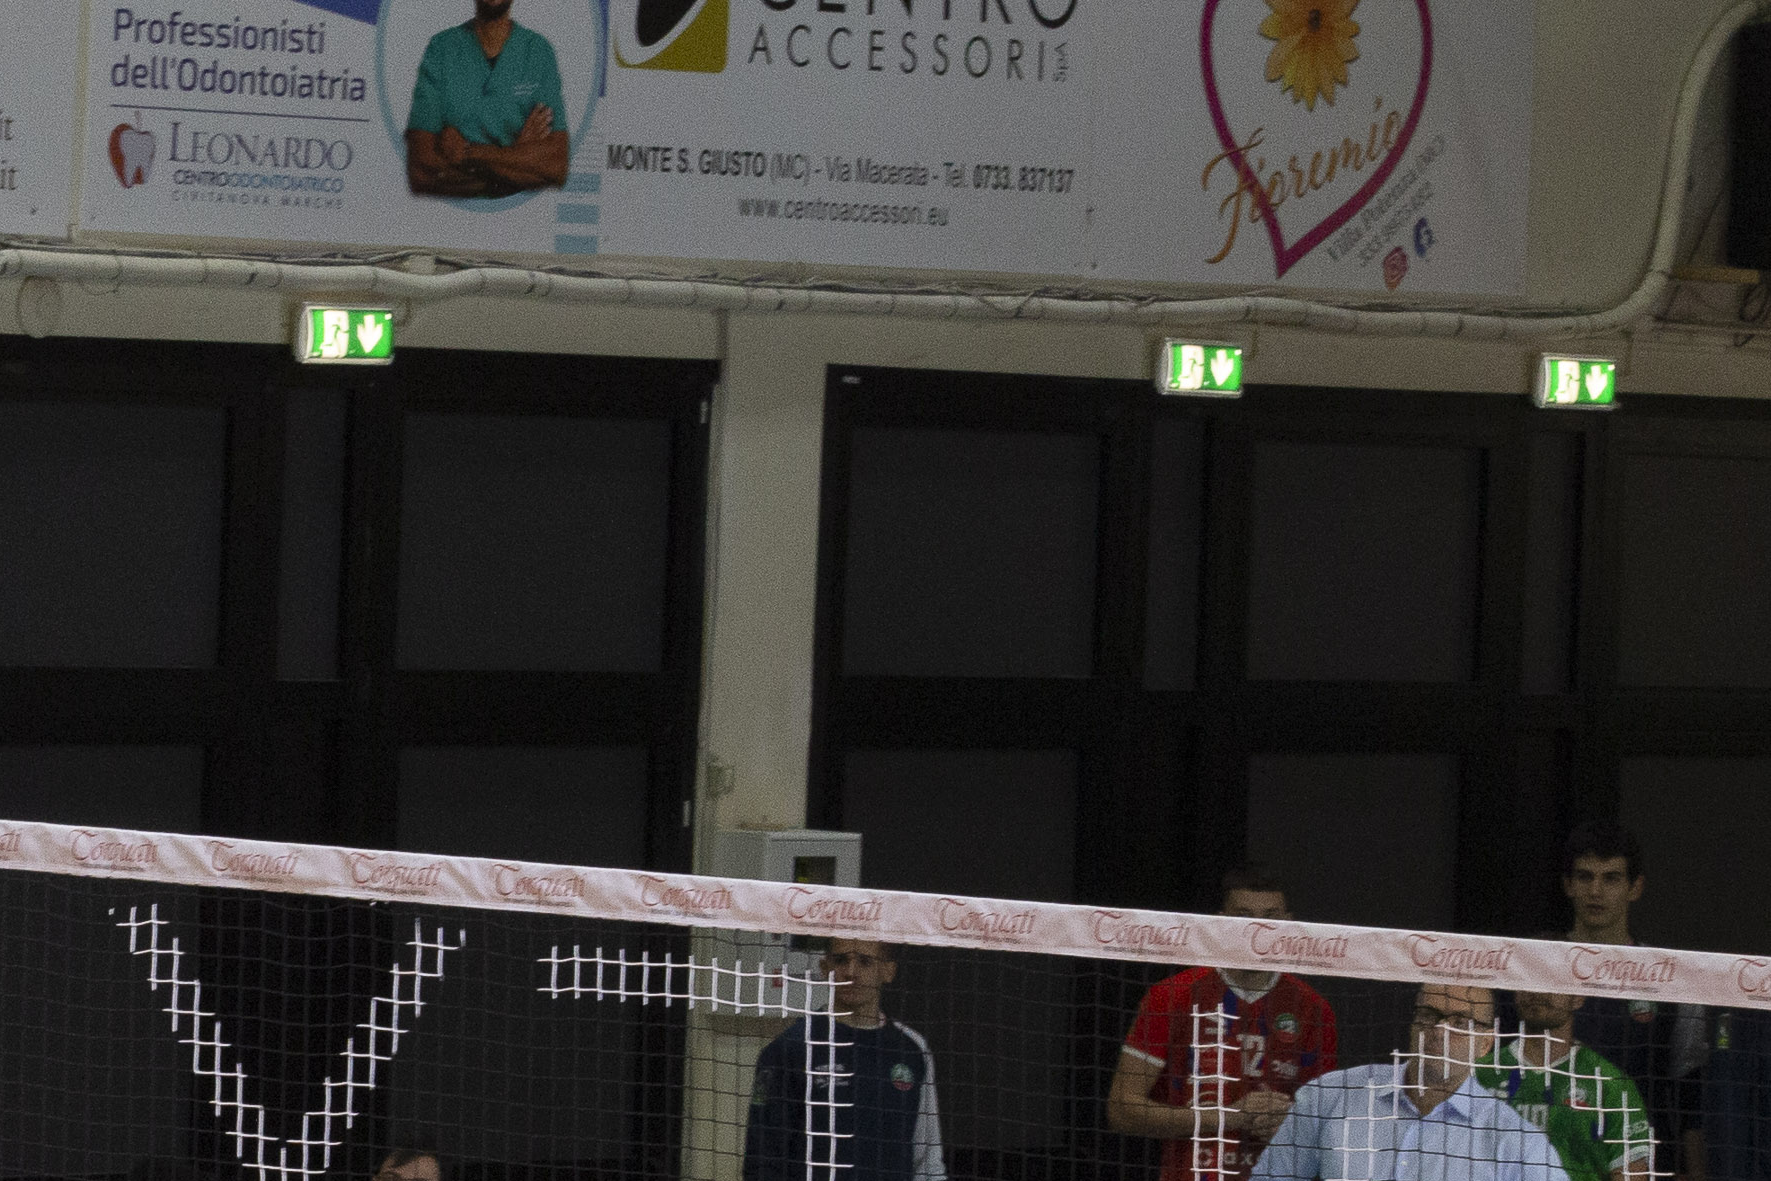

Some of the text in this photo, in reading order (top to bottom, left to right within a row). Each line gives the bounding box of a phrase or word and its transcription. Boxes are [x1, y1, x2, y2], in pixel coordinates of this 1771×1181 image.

[112, 8, 327, 56] Professionisti
[747, 24, 1048, 83] ACCESSORI
[111, 55, 367, 102] dell'Odontoiatria
[607, 144, 673, 174] MONTE
[677, 148, 693, 175] S.
[697, 149, 767, 179] GIUSTO
[770, 153, 812, 187] (MC)
[827, 157, 851, 184] Via
[855, 158, 930, 187] Macerata
[943, 161, 969, 188] Tel.
